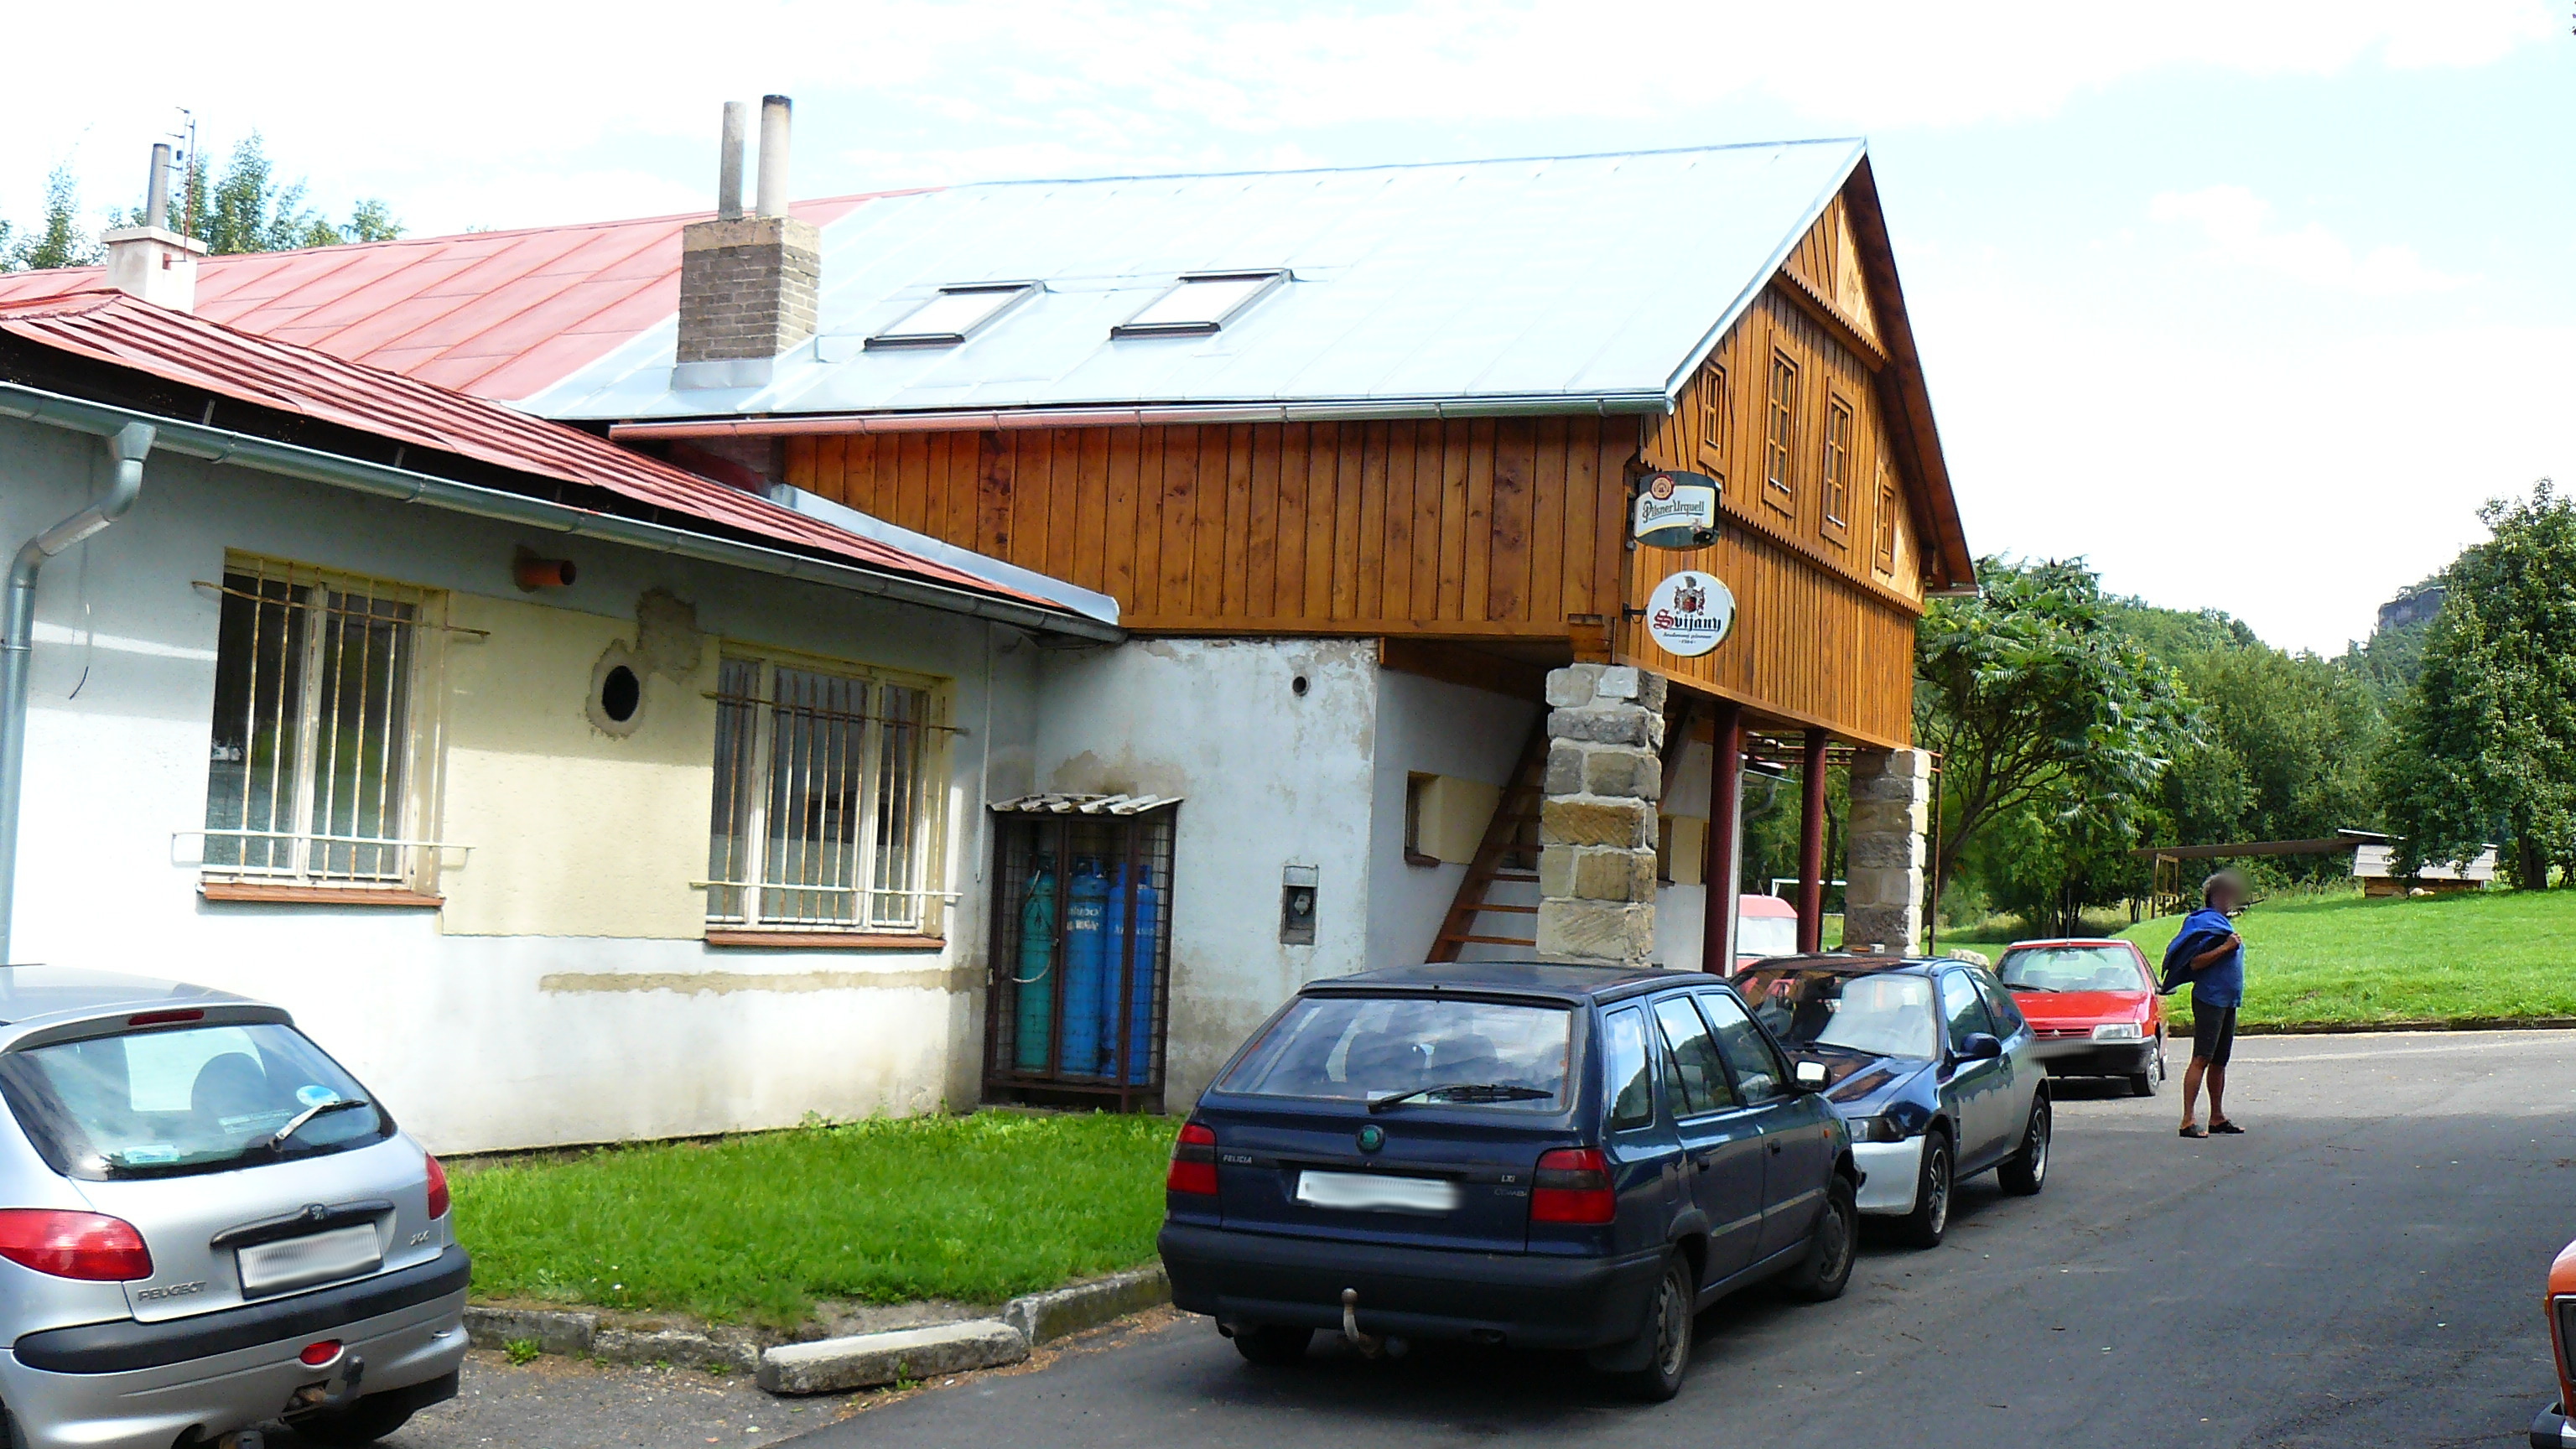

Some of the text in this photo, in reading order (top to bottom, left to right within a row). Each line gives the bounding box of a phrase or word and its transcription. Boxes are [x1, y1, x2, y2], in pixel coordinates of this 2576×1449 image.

[1642, 499, 1705, 524] Pilsner Urquell
[1653, 609, 1722, 631] Svijany
[1223, 1154, 1252, 1164] FELICIA
[138, 1281, 206, 1301] PEUGEOT
